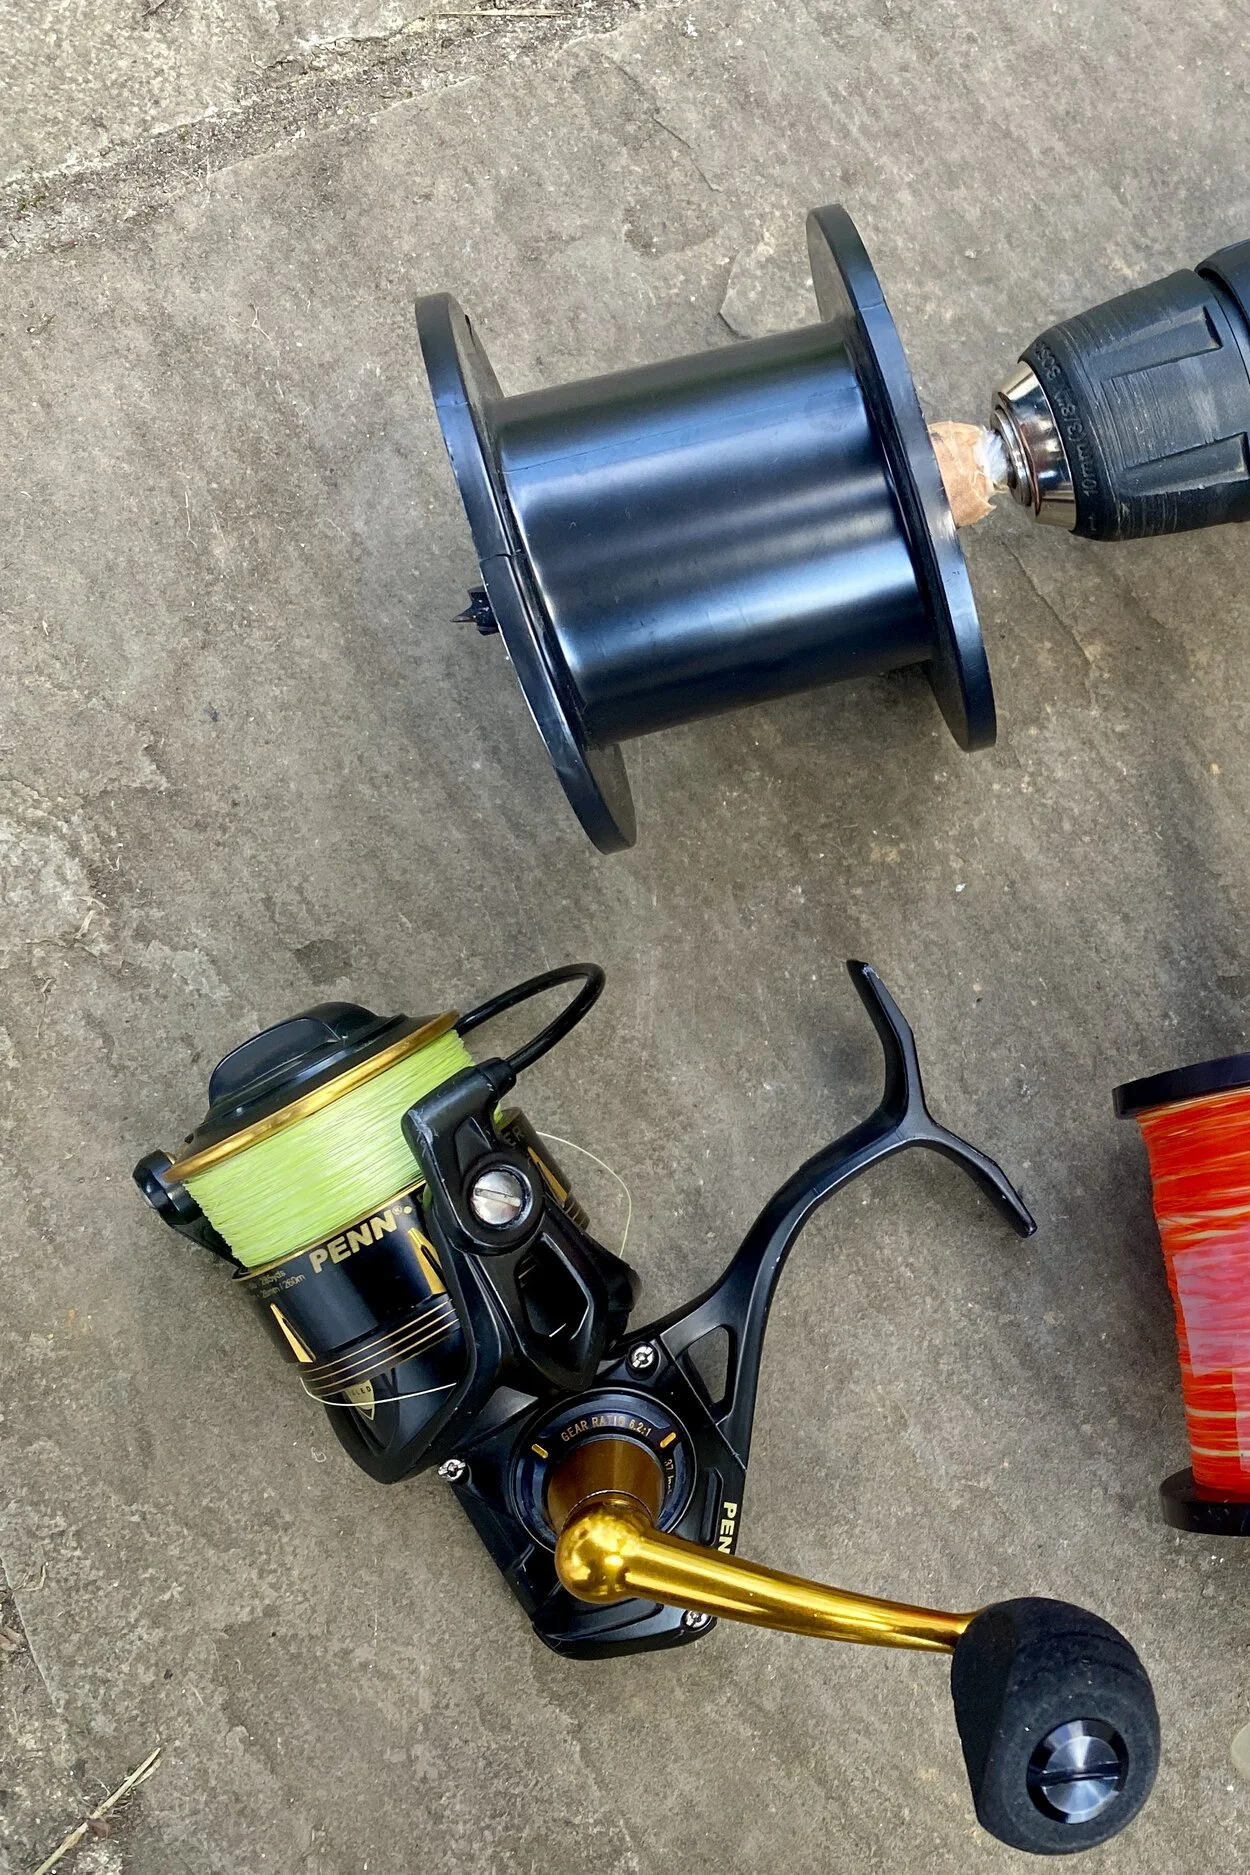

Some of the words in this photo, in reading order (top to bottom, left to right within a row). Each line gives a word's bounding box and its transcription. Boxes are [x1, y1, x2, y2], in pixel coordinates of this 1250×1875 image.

[561, 1420, 589, 1442] GEAR
[592, 1415, 626, 1428] RATIO
[628, 1419, 652, 1437] 6.2:1
[717, 1501, 738, 1555] PEN
